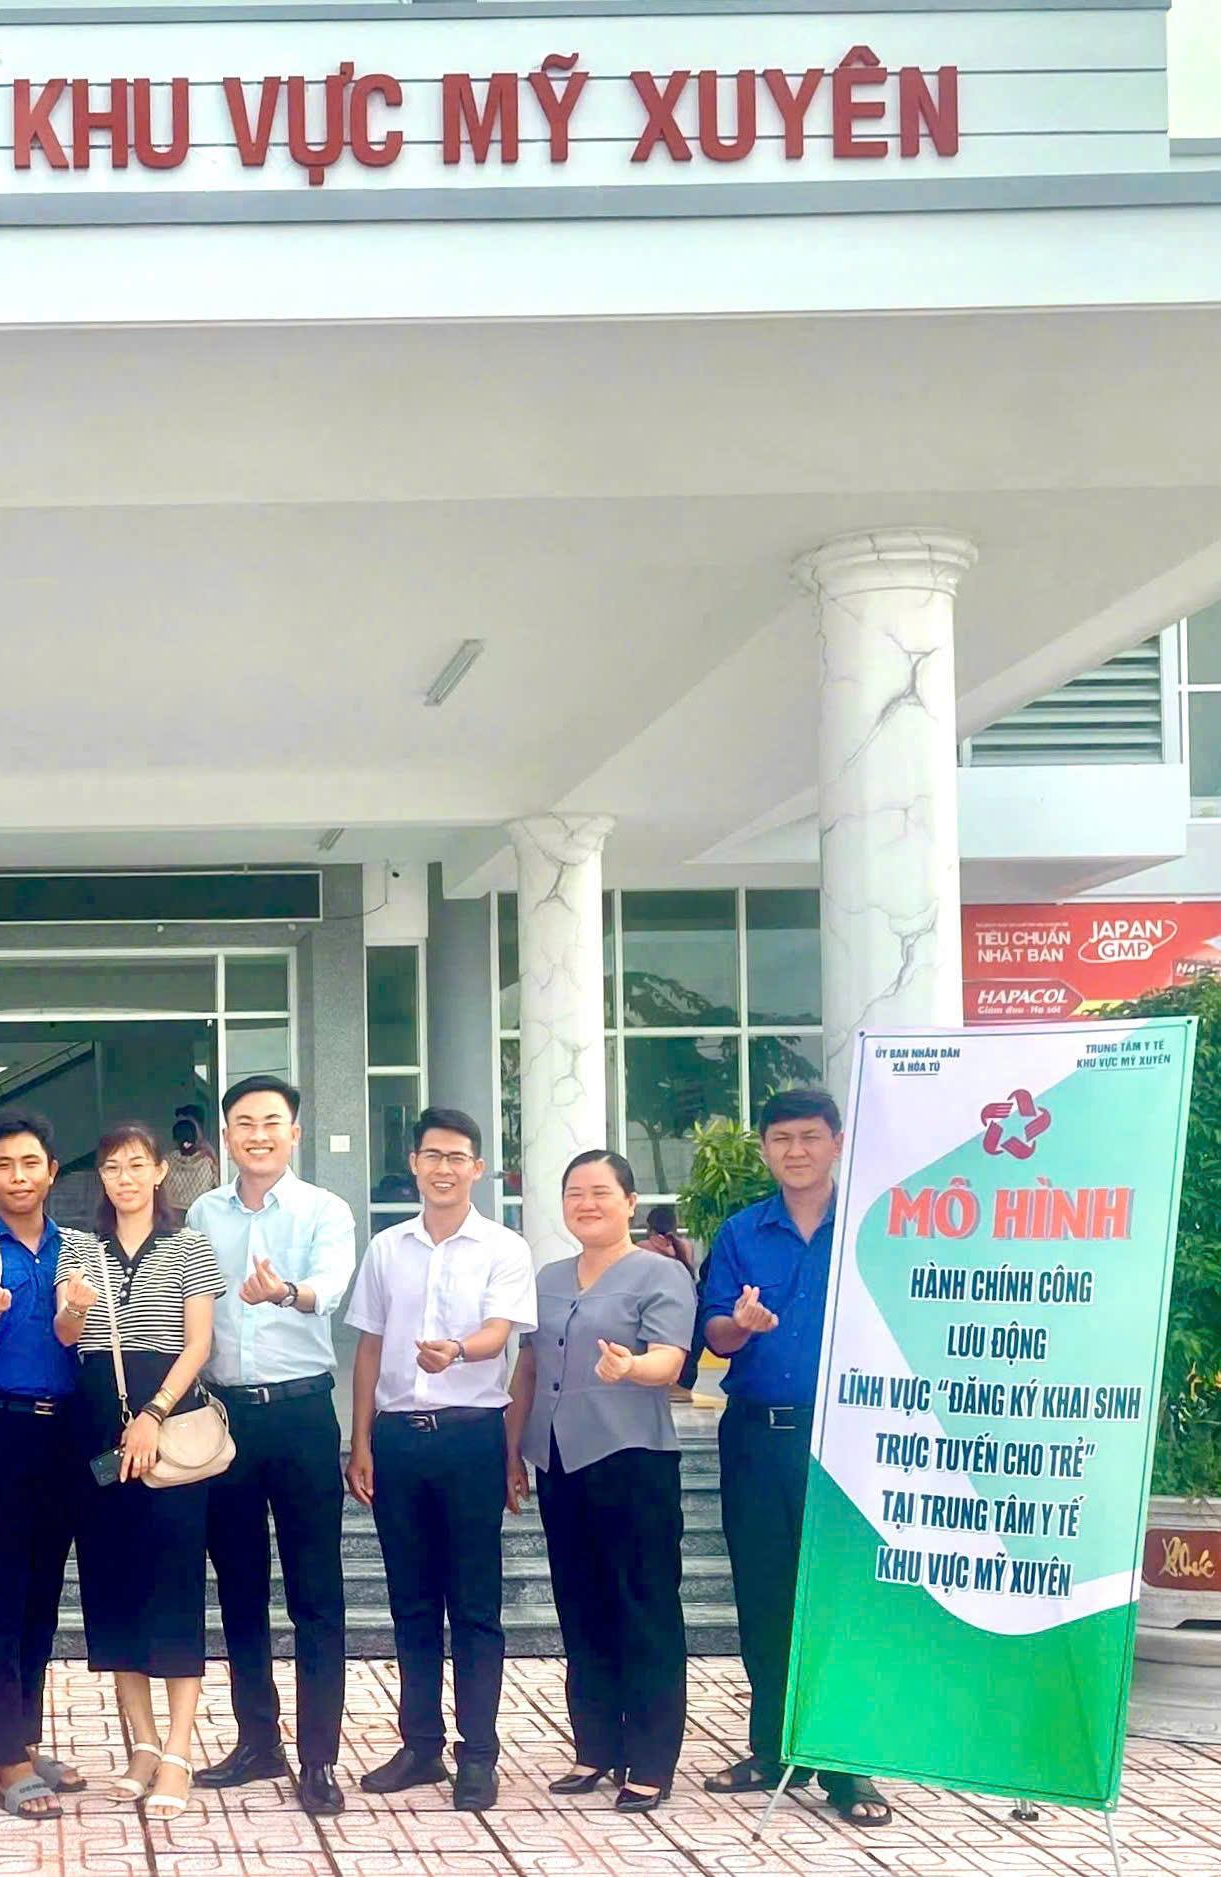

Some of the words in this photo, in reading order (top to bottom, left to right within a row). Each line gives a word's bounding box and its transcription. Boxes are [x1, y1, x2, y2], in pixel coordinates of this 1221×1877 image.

[13, 77, 189, 171] KHU
[222, 61, 403, 186] VỰC
[442, 52, 590, 167] MỸ
[630, 44, 960, 162] XUYÊN
[1088, 920, 1163, 943] JAPAN
[1101, 942, 1149, 958] GMP
[977, 988, 1069, 1005] HAPACOL
[890, 1048, 909, 1058] BAN
[911, 1046, 938, 1058] NHÂN
[940, 1046, 960, 1058] DÂN
[1076, 1058, 1097, 1068] KHU
[1139, 1053, 1172, 1066] XUYÊN
[1086, 1043, 1118, 1054] TRUNG
[1121, 1040, 1141, 1052] TÂM
[1144, 1041, 1151, 1051] Y
[887, 1176, 981, 1239] MÔ
[992, 1176, 1135, 1240] HÌNH
[910, 1262, 967, 1300] HÀNH
[971, 1264, 1034, 1302] CHÍNH
[1038, 1264, 1093, 1303] CÔNG
[947, 1323, 986, 1358] LƯU
[990, 1321, 1047, 1366] ĐỘNG
[838, 1367, 884, 1407] LĨNH
[890, 1377, 931, 1416] VỰC
[1009, 1380, 1038, 1416] KÝ
[1042, 1387, 1089, 1418] KHAI
[1094, 1387, 1142, 1420] SINH
[875, 1432, 930, 1473] TRỰC
[935, 1432, 999, 1474] TUYẾN
[1003, 1443, 1044, 1476] CHO
[882, 1490, 915, 1530] TẠI
[921, 1494, 988, 1532] TRUNG
[994, 1494, 1036, 1535] TÂM
[1042, 1503, 1053, 1536] Y
[1058, 1495, 1084, 1537] TẾ
[877, 1547, 922, 1584] KHU
[928, 1551, 969, 1594] VỰC
[974, 1551, 1006, 1592] MỸ
[1010, 1555, 1071, 1597] XUYÊN
